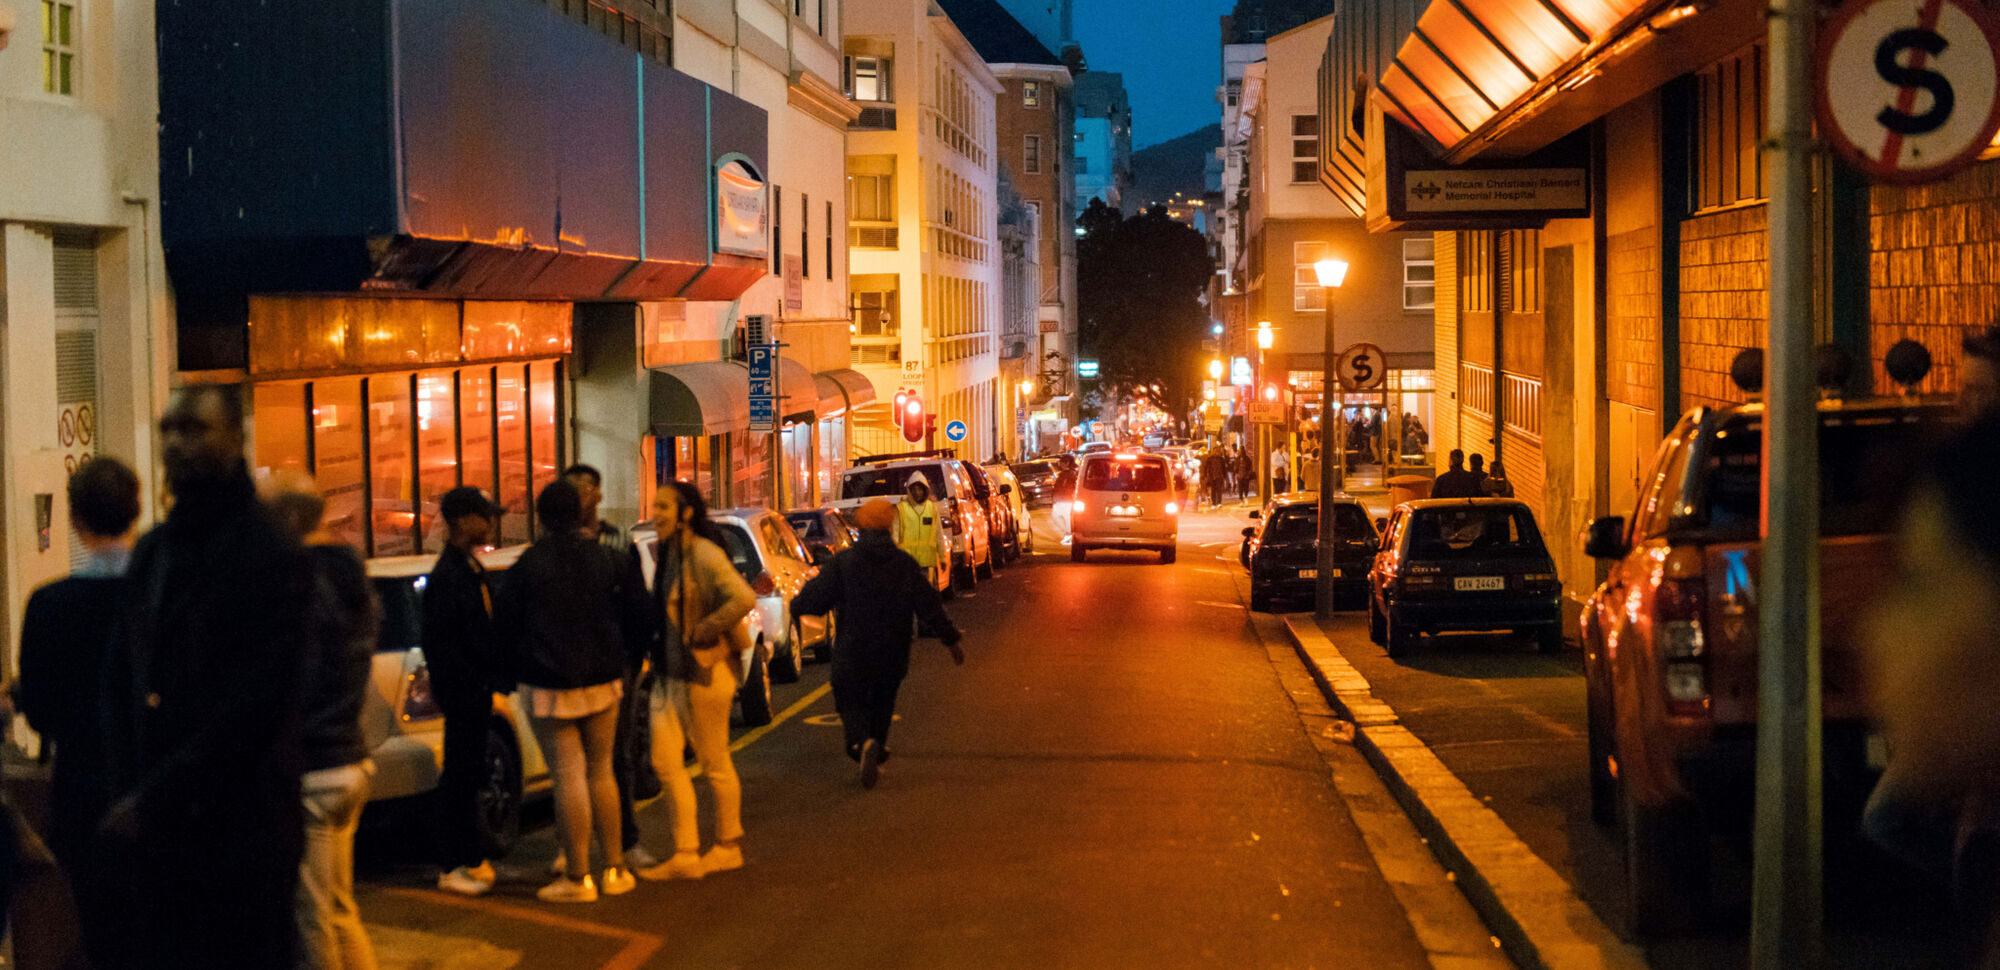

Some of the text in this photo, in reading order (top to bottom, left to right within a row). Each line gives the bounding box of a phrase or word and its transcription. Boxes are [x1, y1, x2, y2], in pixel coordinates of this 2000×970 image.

[1875, 29, 1955, 134] S
[1445, 178, 1581, 189] Netcare Christiaan Barnard
[1445, 190, 1536, 201] Memorial Hospital
[754, 350, 765, 364] P
[751, 367, 760, 375] 60
[905, 361, 919, 371] 87
[1352, 355, 1373, 382] S
[1457, 578, 1501, 589] CAW 24467
